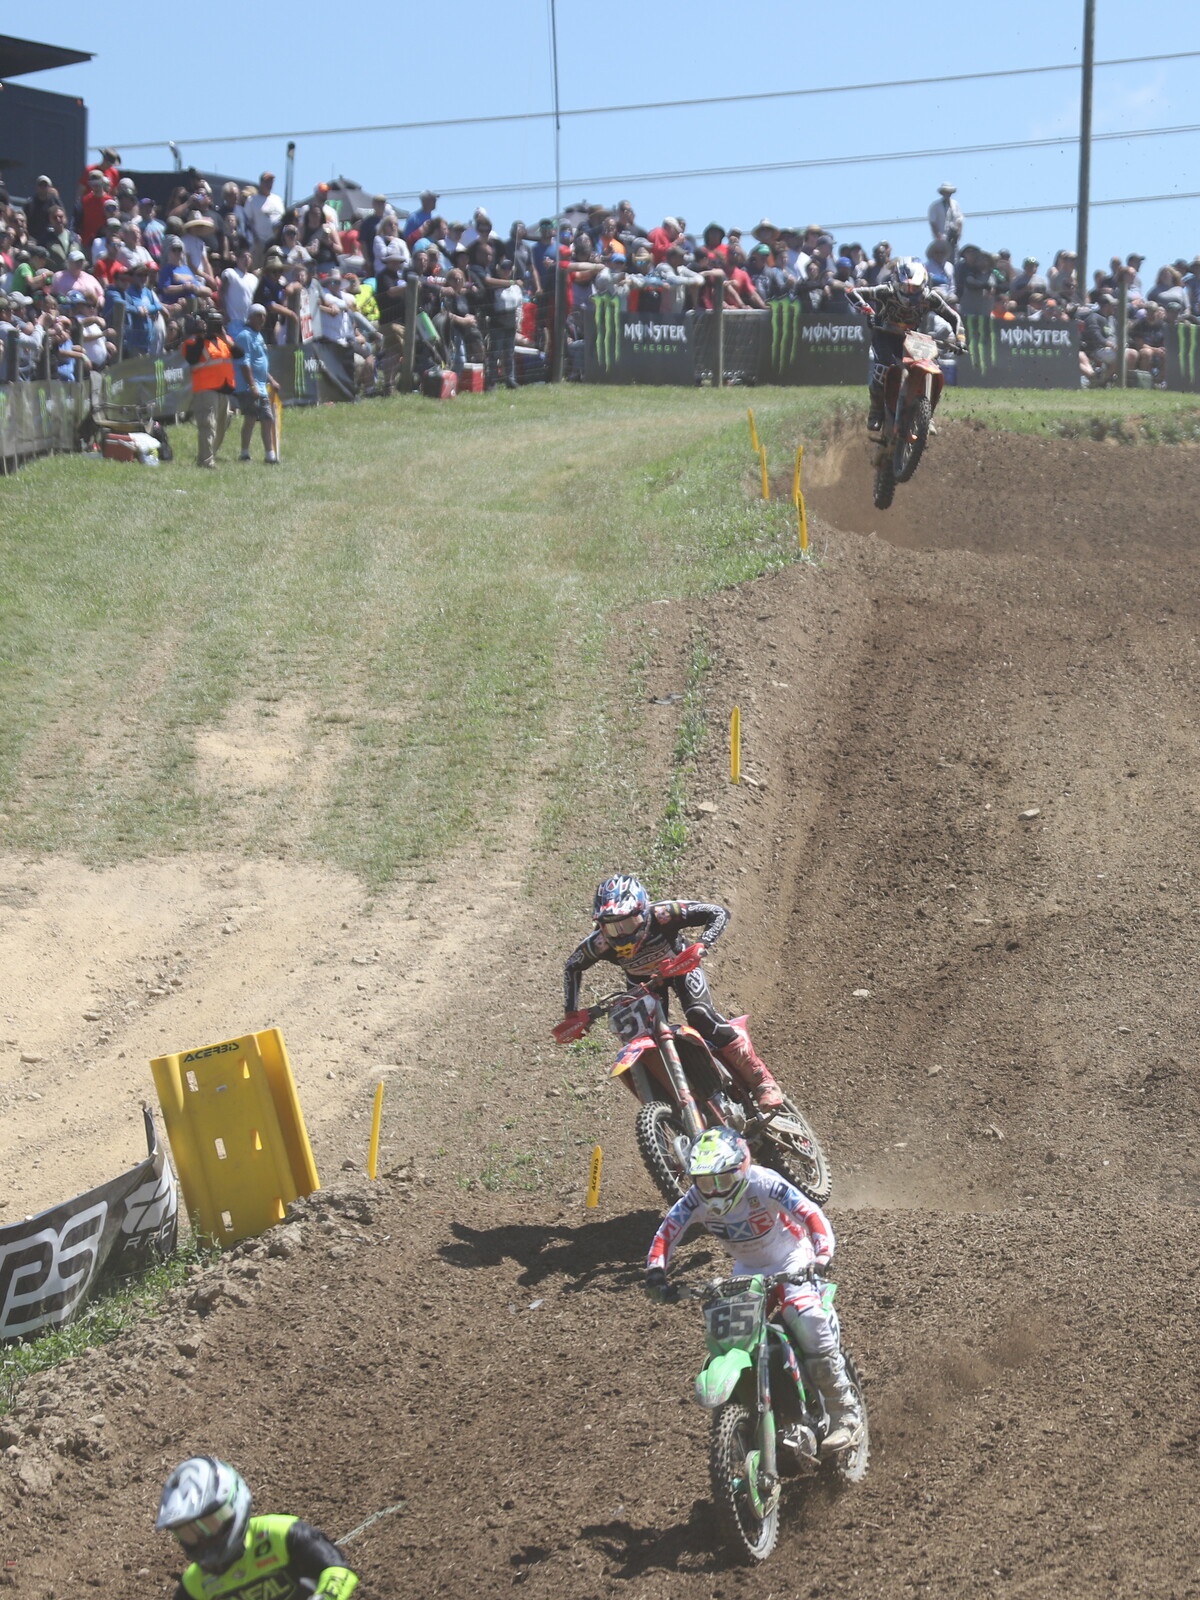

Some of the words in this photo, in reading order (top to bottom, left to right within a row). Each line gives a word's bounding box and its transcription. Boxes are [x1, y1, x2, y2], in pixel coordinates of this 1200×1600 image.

[624, 321, 687, 343] MONSTER
[802, 322, 864, 343] MONSTER
[1000, 325, 1072, 347] MONSTER
[612, 998, 655, 1039] 51
[183, 1042, 240, 1063] ACERBIS
[711, 1303, 755, 1340] 65
